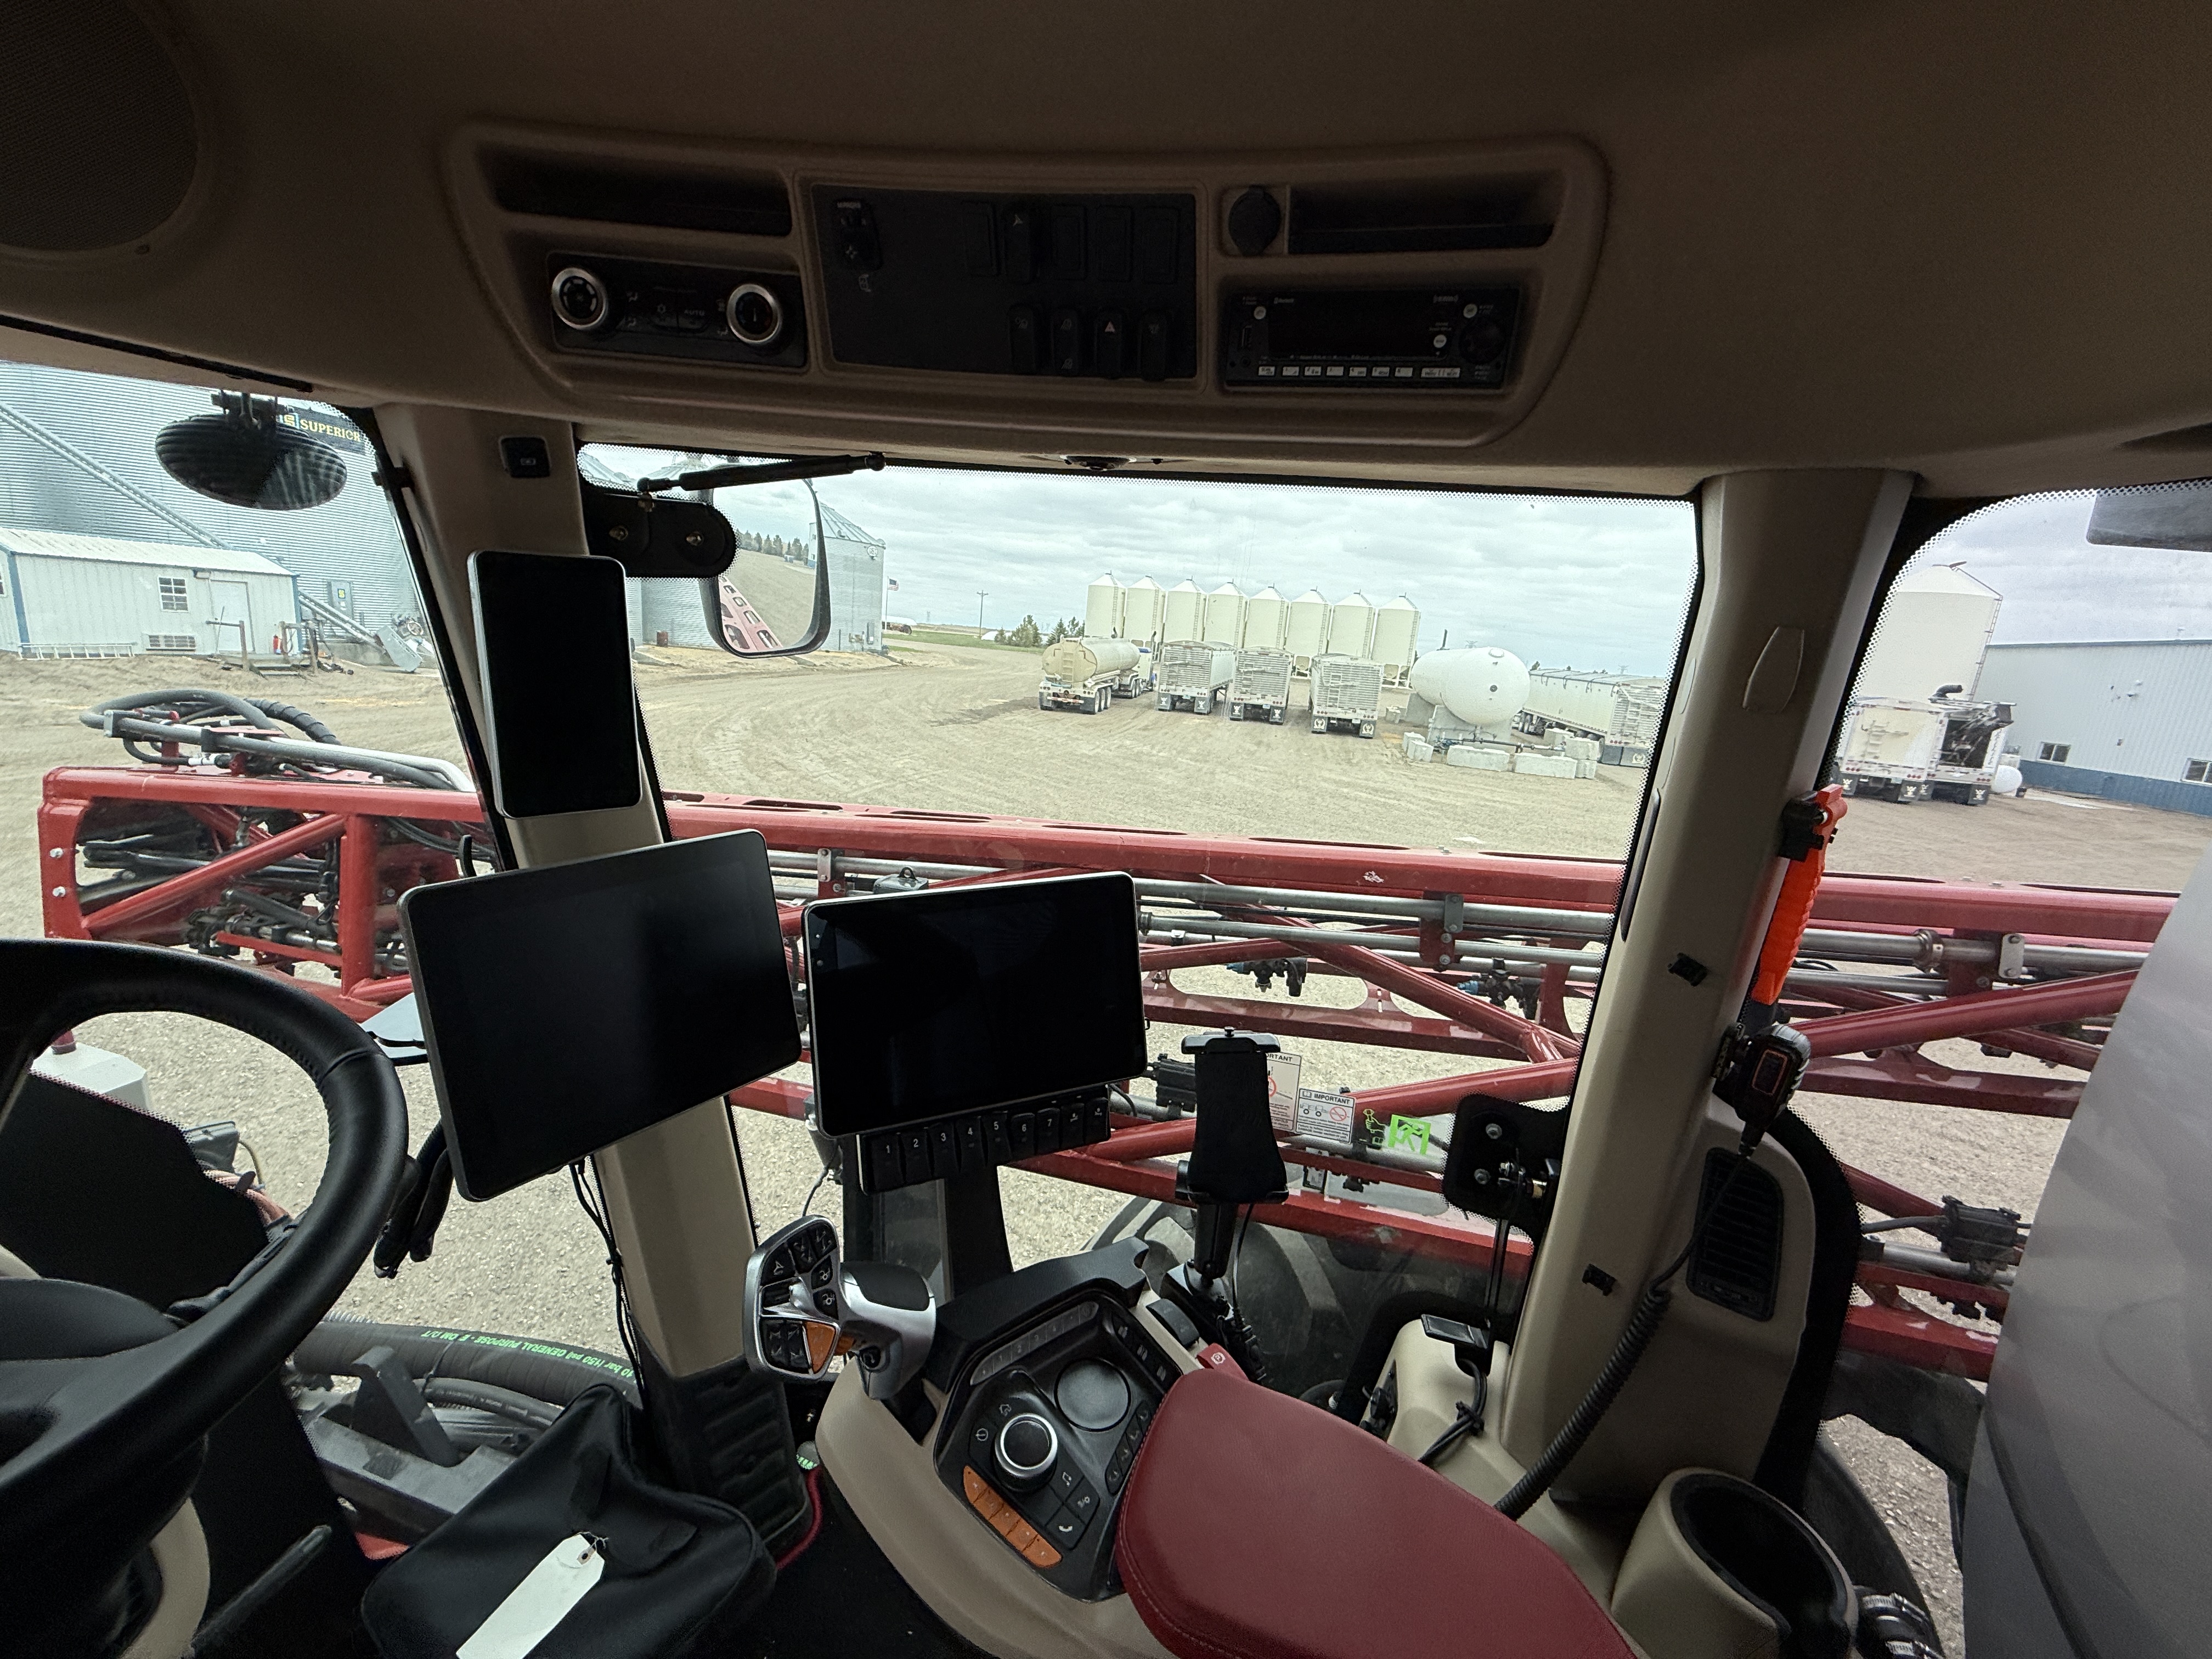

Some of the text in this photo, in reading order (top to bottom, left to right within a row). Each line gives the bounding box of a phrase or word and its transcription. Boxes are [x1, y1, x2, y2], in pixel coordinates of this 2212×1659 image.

[1314, 1093, 1350, 1104] IMPORTANT
[885, 1119, 1052, 1154] 1 2 3 4 5 6 7
[473, 1336, 522, 1348] PURPOSE
[522, 1342, 567, 1357] GENERAL
[603, 1362, 623, 1373] bar
[621, 1368, 634, 1378] 10
